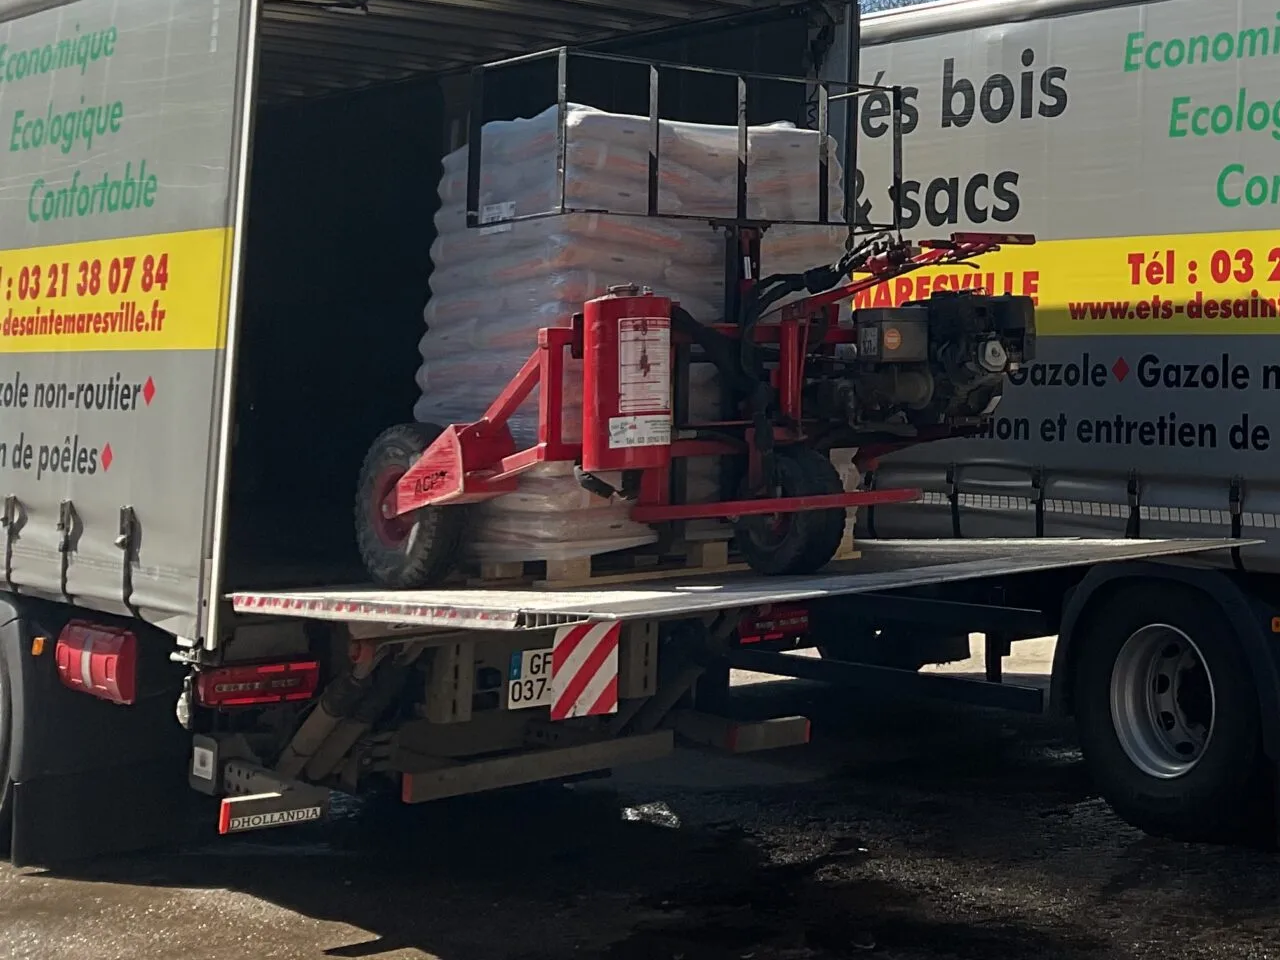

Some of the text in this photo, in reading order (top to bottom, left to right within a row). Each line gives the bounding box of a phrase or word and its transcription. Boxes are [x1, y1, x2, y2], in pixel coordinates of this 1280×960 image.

[941, 48, 1068, 128] bois
[9, 96, 123, 154] Ecologique
[28, 159, 158, 223] Confortable
[899, 171, 1020, 229] sacs
[18, 264, 41, 300] 03
[46, 263, 69, 298] 21
[76, 259, 101, 296] 38
[108, 257, 135, 295] 07
[141, 253, 168, 292] 84
[1127, 250, 1175, 285] Tél
[1210, 249, 1254, 283] 03
[0, 301, 165, 336] desaintemaresville.fr
[0, 371, 141, 410] ole non-routier
[1137, 353, 1250, 389] Gazole
[1040, 413, 1068, 442] et
[1077, 411, 1217, 449] entretien
[1229, 413, 1270, 451] de
[12, 432, 33, 470] de
[37, 434, 98, 480] poêles
[232, 807, 318, 830] DHOLLANDIA
